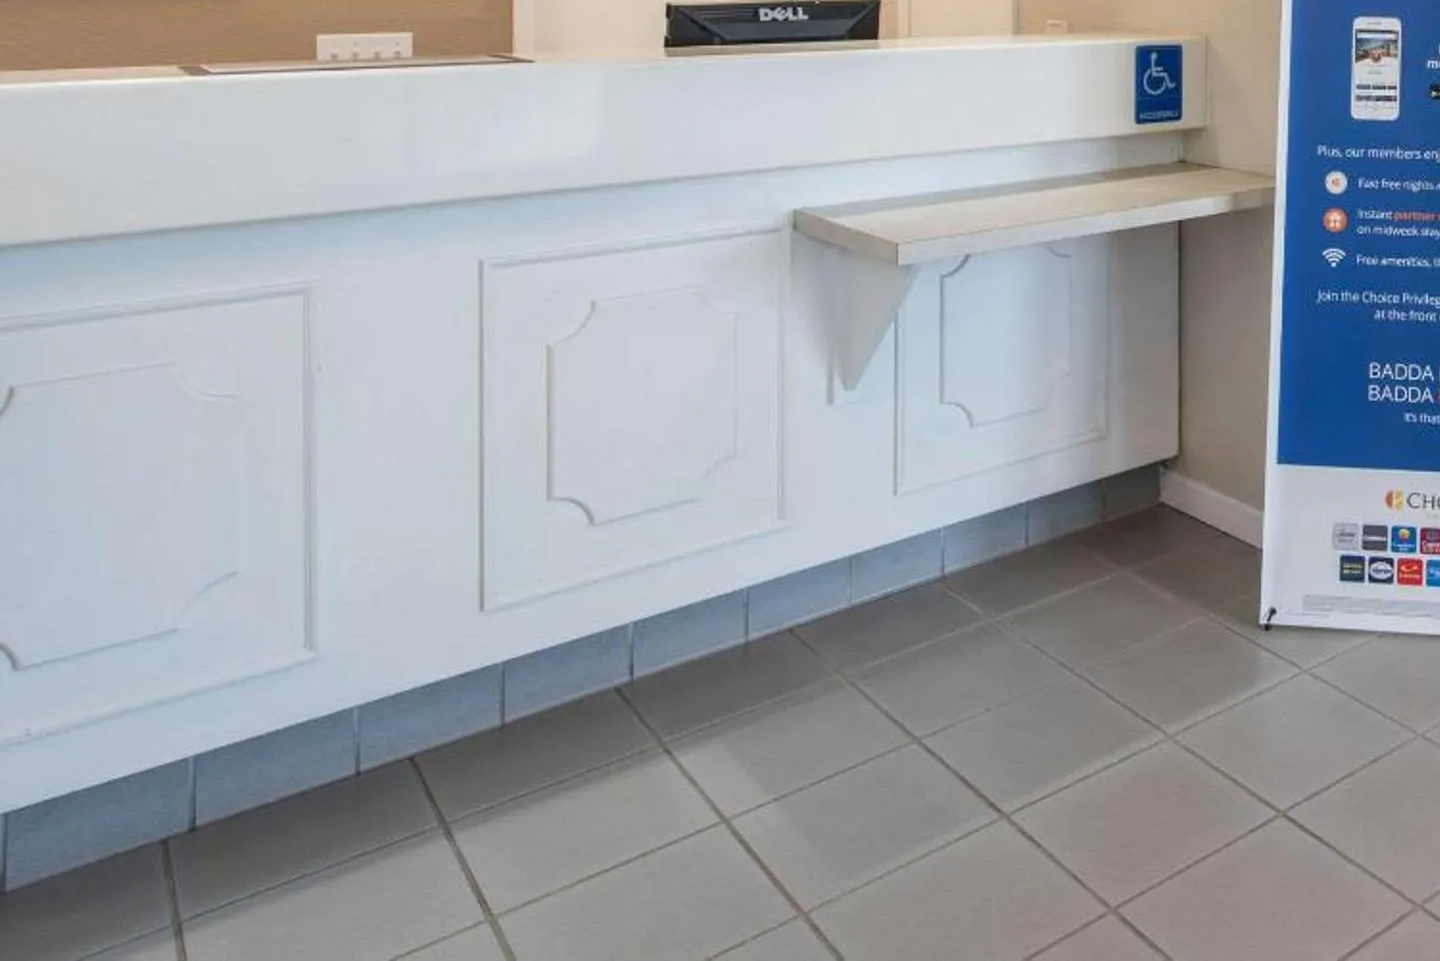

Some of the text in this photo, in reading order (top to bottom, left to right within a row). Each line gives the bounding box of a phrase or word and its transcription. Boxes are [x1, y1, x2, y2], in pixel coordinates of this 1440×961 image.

[758, 7, 808, 22] DELL
[1345, 147, 1366, 158] our
[1368, 148, 1421, 159] members
[1317, 290, 1339, 304] Join
[1341, 291, 1359, 302] the
[1362, 291, 1400, 304] Choice
[1369, 362, 1434, 381] BADDA
[1368, 384, 1434, 403] BADDA
[1419, 412, 1440, 424] that
